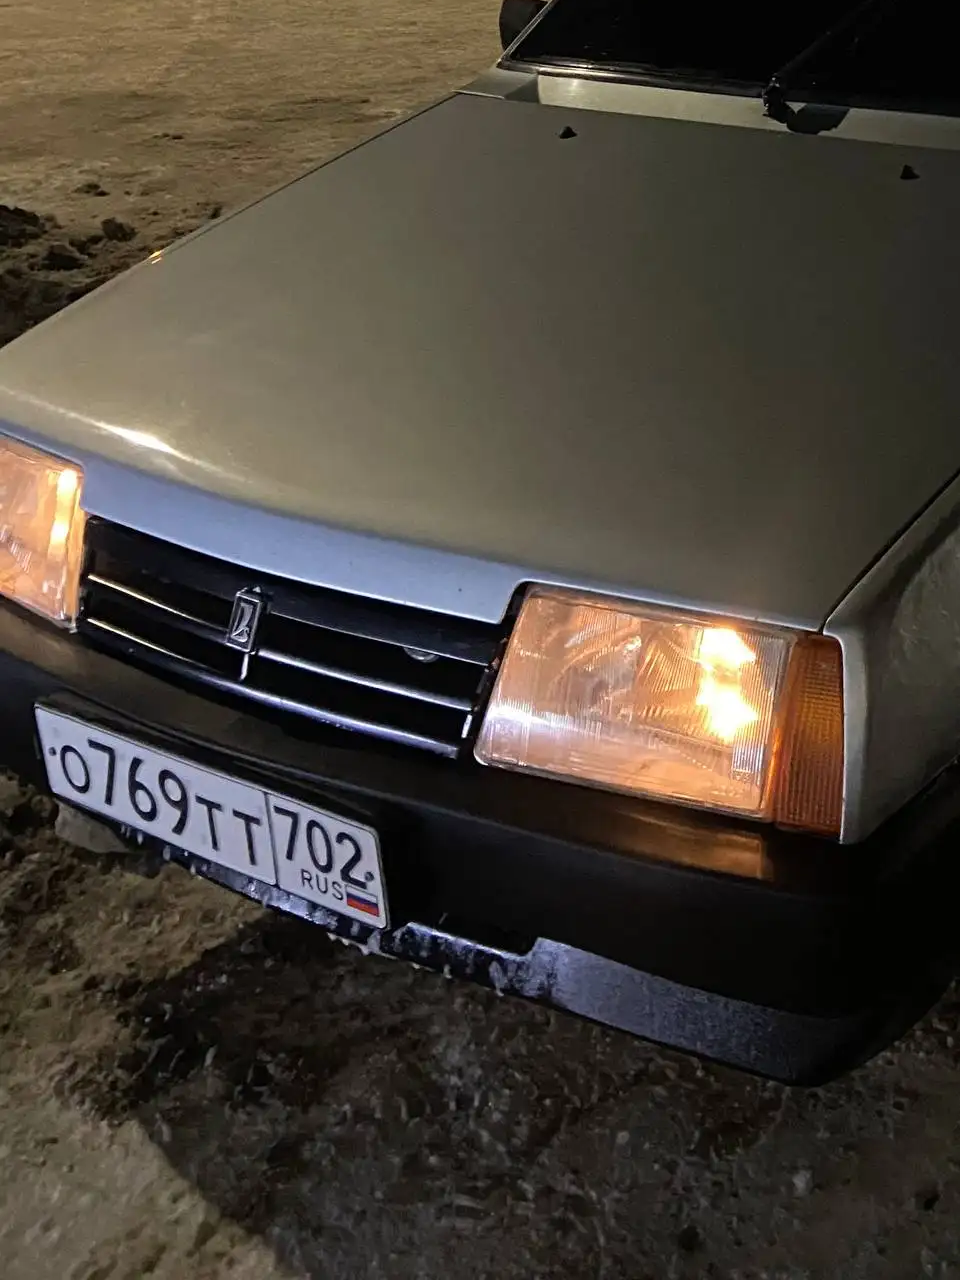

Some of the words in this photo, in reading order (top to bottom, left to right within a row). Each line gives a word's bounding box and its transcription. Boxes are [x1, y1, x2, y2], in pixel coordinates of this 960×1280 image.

[60, 739, 261, 866] O769TT
[274, 805, 367, 890] 702
[300, 868, 344, 902] RUS
